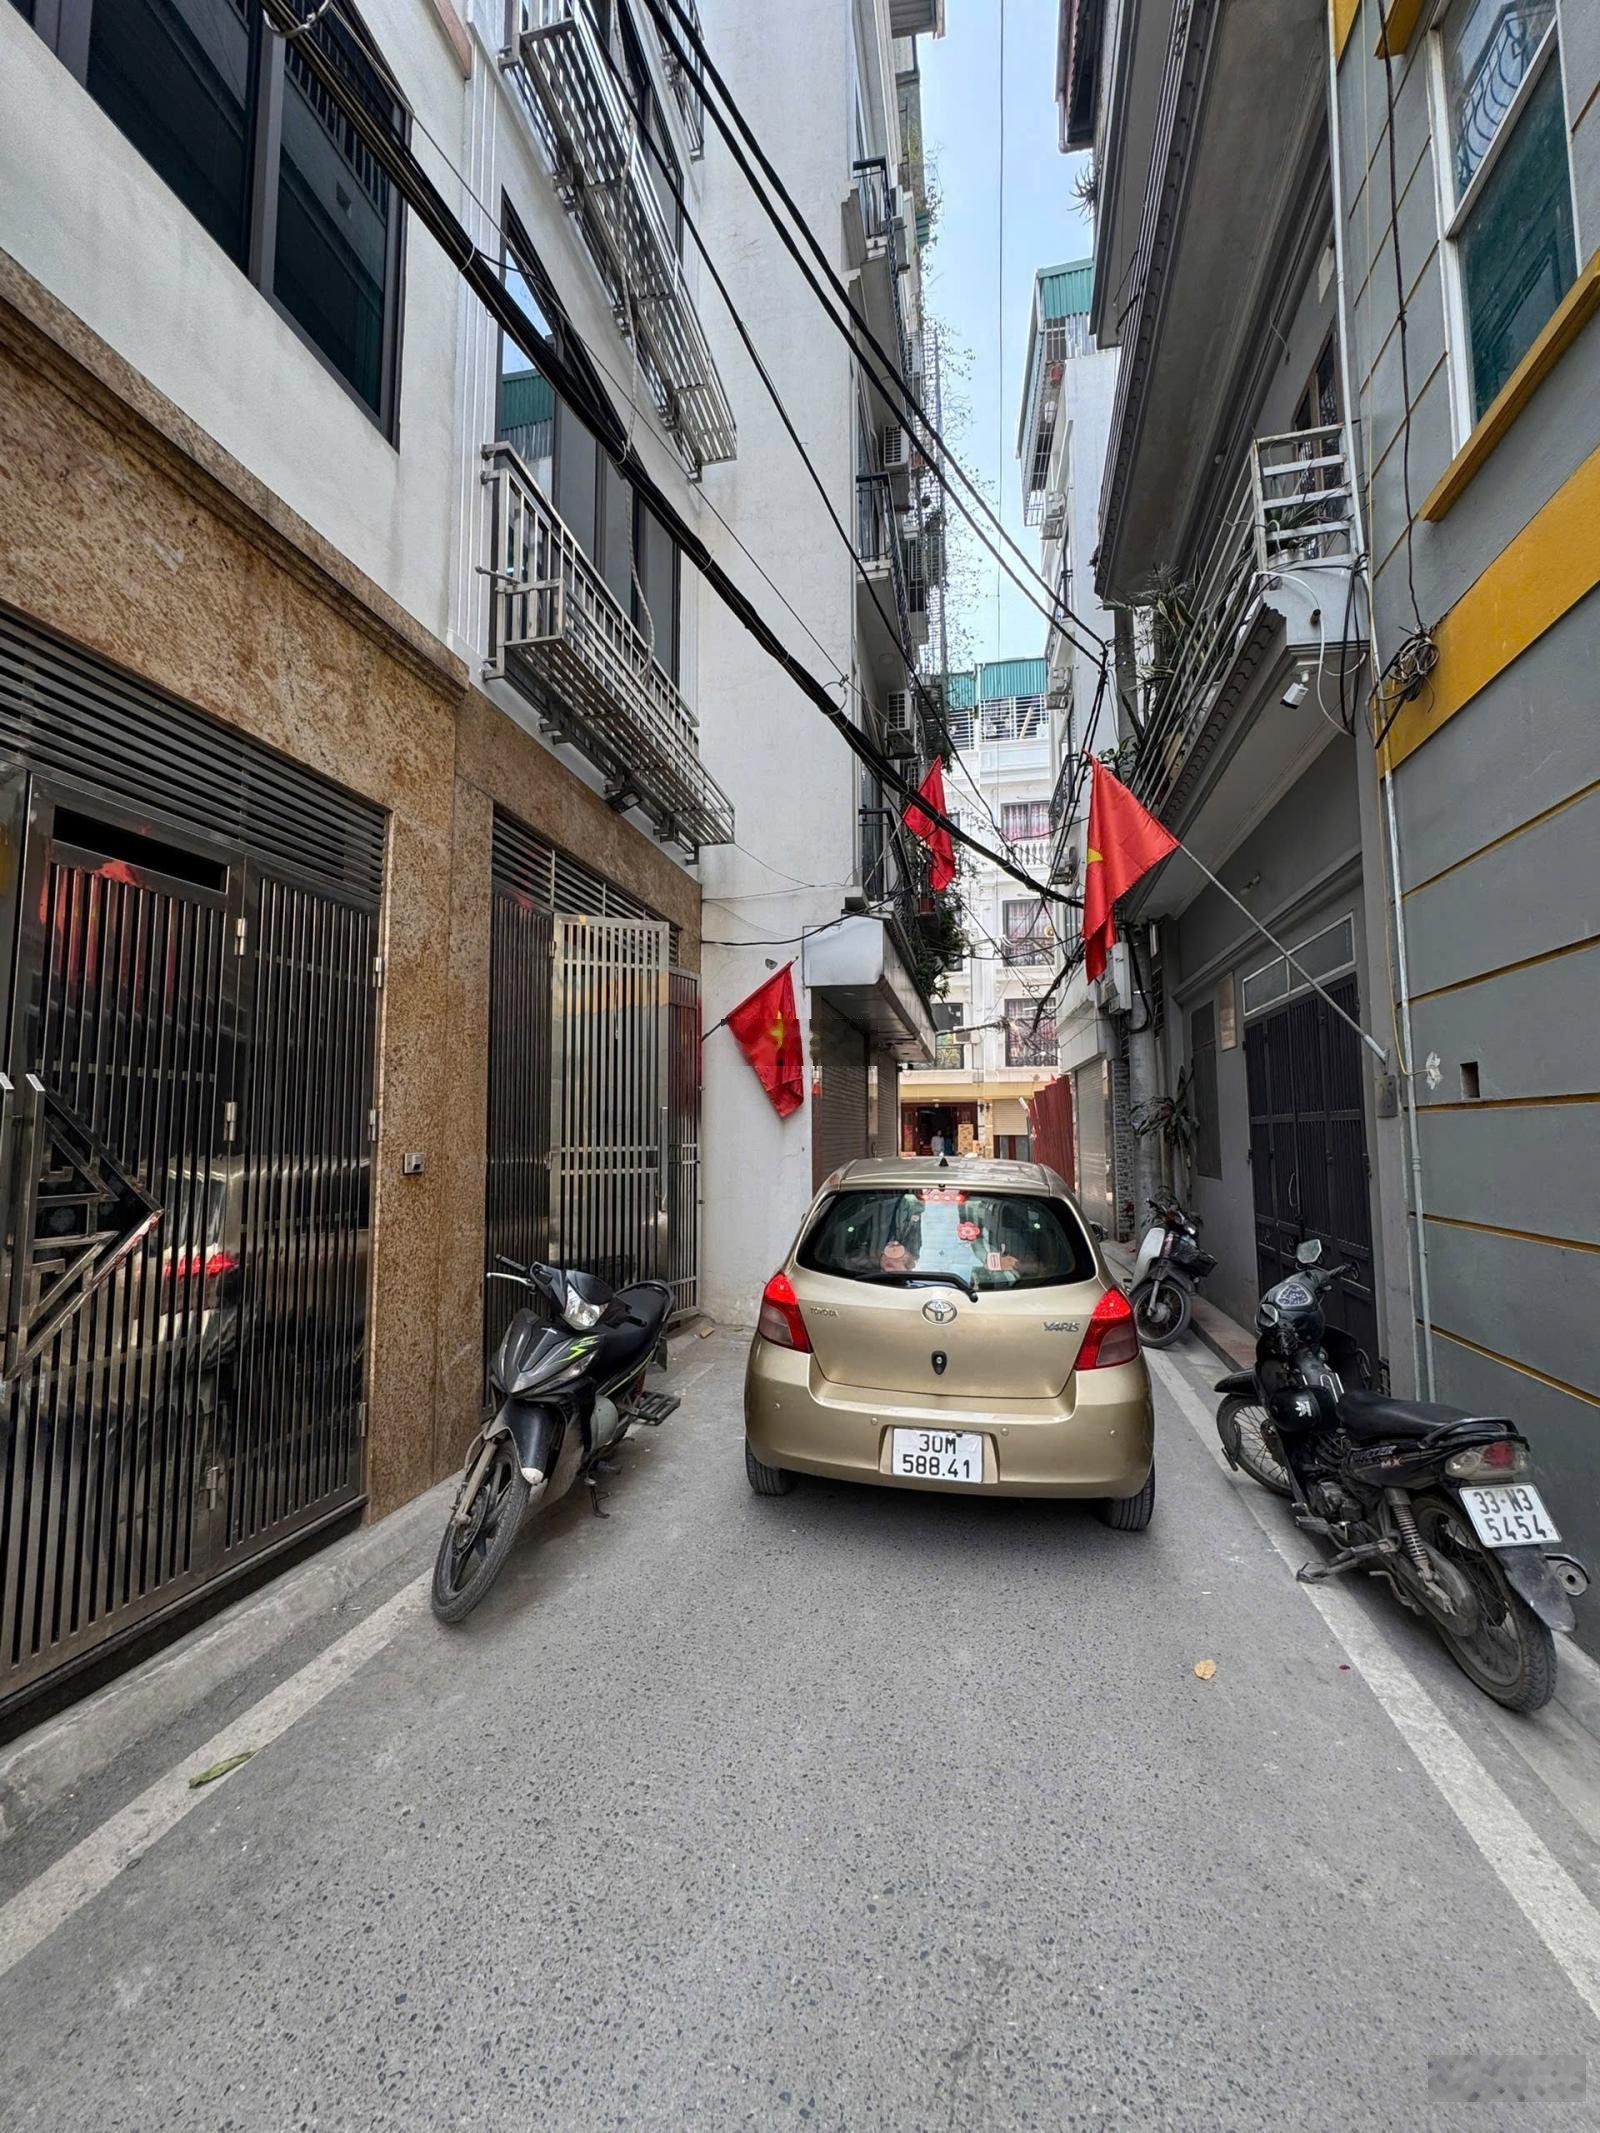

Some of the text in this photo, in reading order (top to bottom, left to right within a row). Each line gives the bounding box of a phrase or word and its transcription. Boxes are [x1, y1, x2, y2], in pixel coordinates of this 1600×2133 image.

[810, 1306, 839, 1318] TOYOTA
[1042, 1320, 1081, 1333] YARIS
[918, 1433, 957, 1455] 30M
[902, 1453, 971, 1479] 588.41
[1473, 1488, 1534, 1514] 33-N3
[1485, 1514, 1547, 1542] 5454
